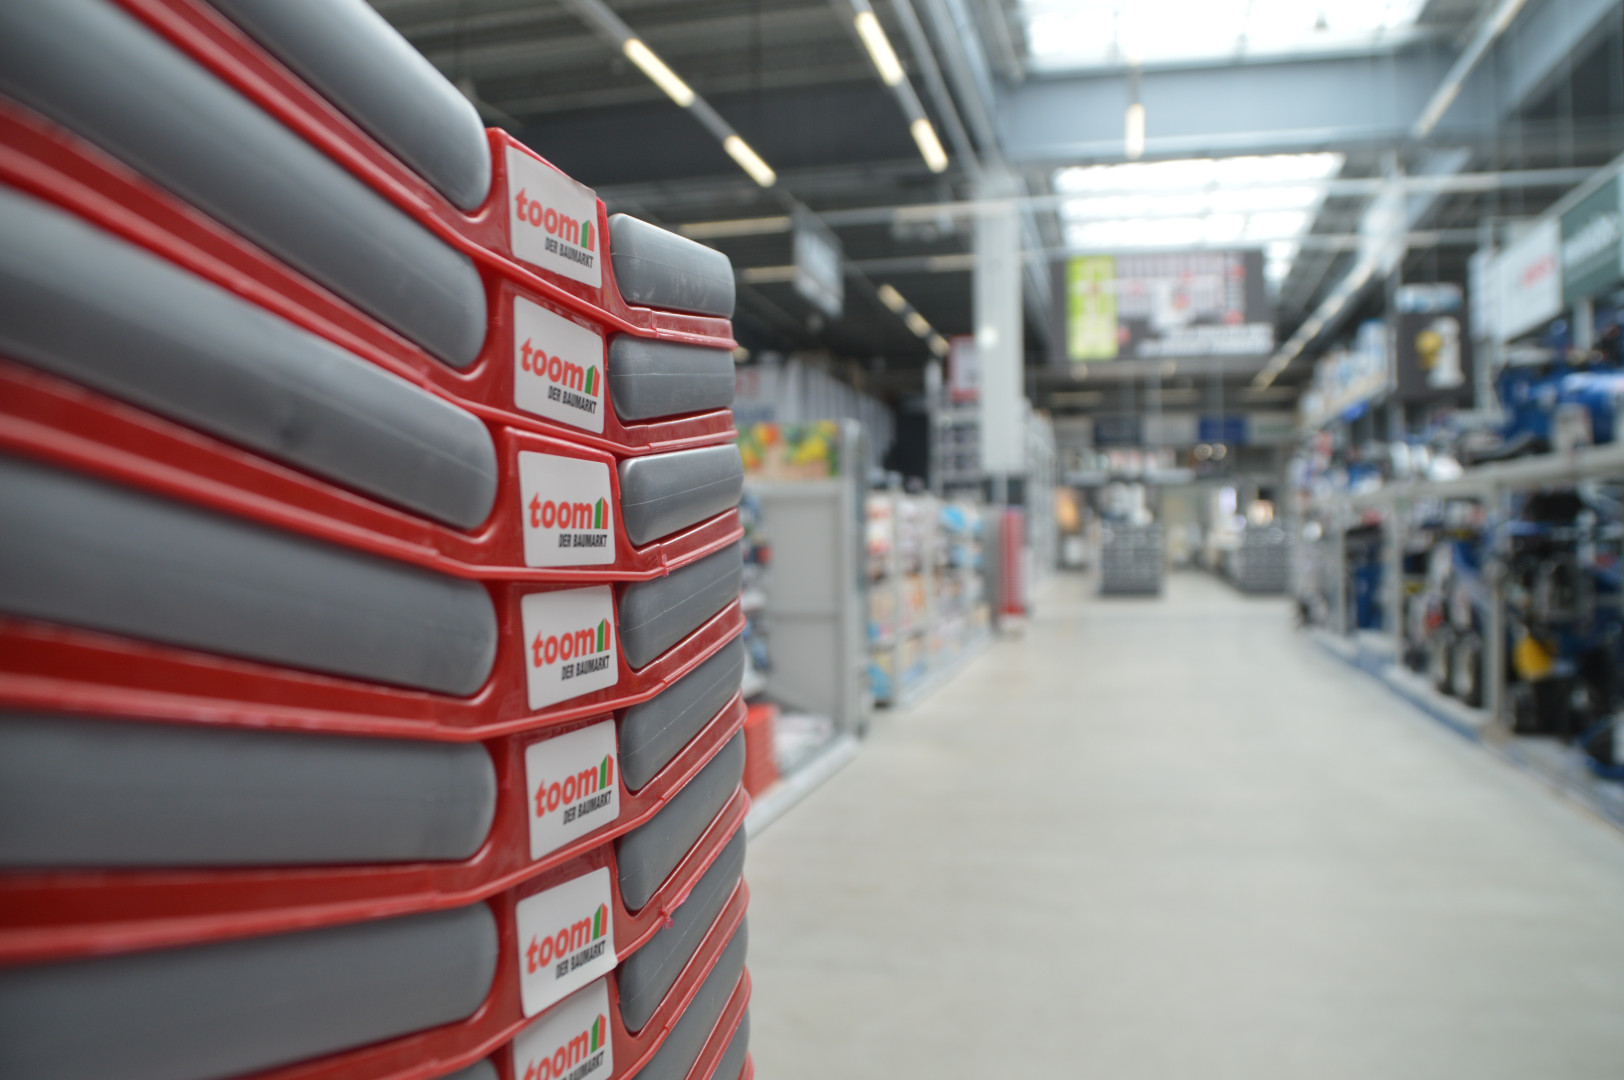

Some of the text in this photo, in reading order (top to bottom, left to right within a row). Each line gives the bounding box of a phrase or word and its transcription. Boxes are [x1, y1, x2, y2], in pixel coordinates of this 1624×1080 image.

[514, 188, 578, 245] toom
[545, 236, 594, 268] DER BAUMARKT
[520, 338, 584, 392] toom
[548, 385, 597, 414] DER BAUMARKT
[529, 492, 592, 530] toom
[558, 534, 608, 548] DER BAUMARKT
[532, 627, 595, 668] toom
[561, 656, 610, 681] DER BAUMARKT
[534, 766, 598, 818] toom
[563, 790, 612, 825] DER BAUMARKT
[526, 916, 590, 974] toom
[556, 940, 606, 980] DER BAUMARKT
